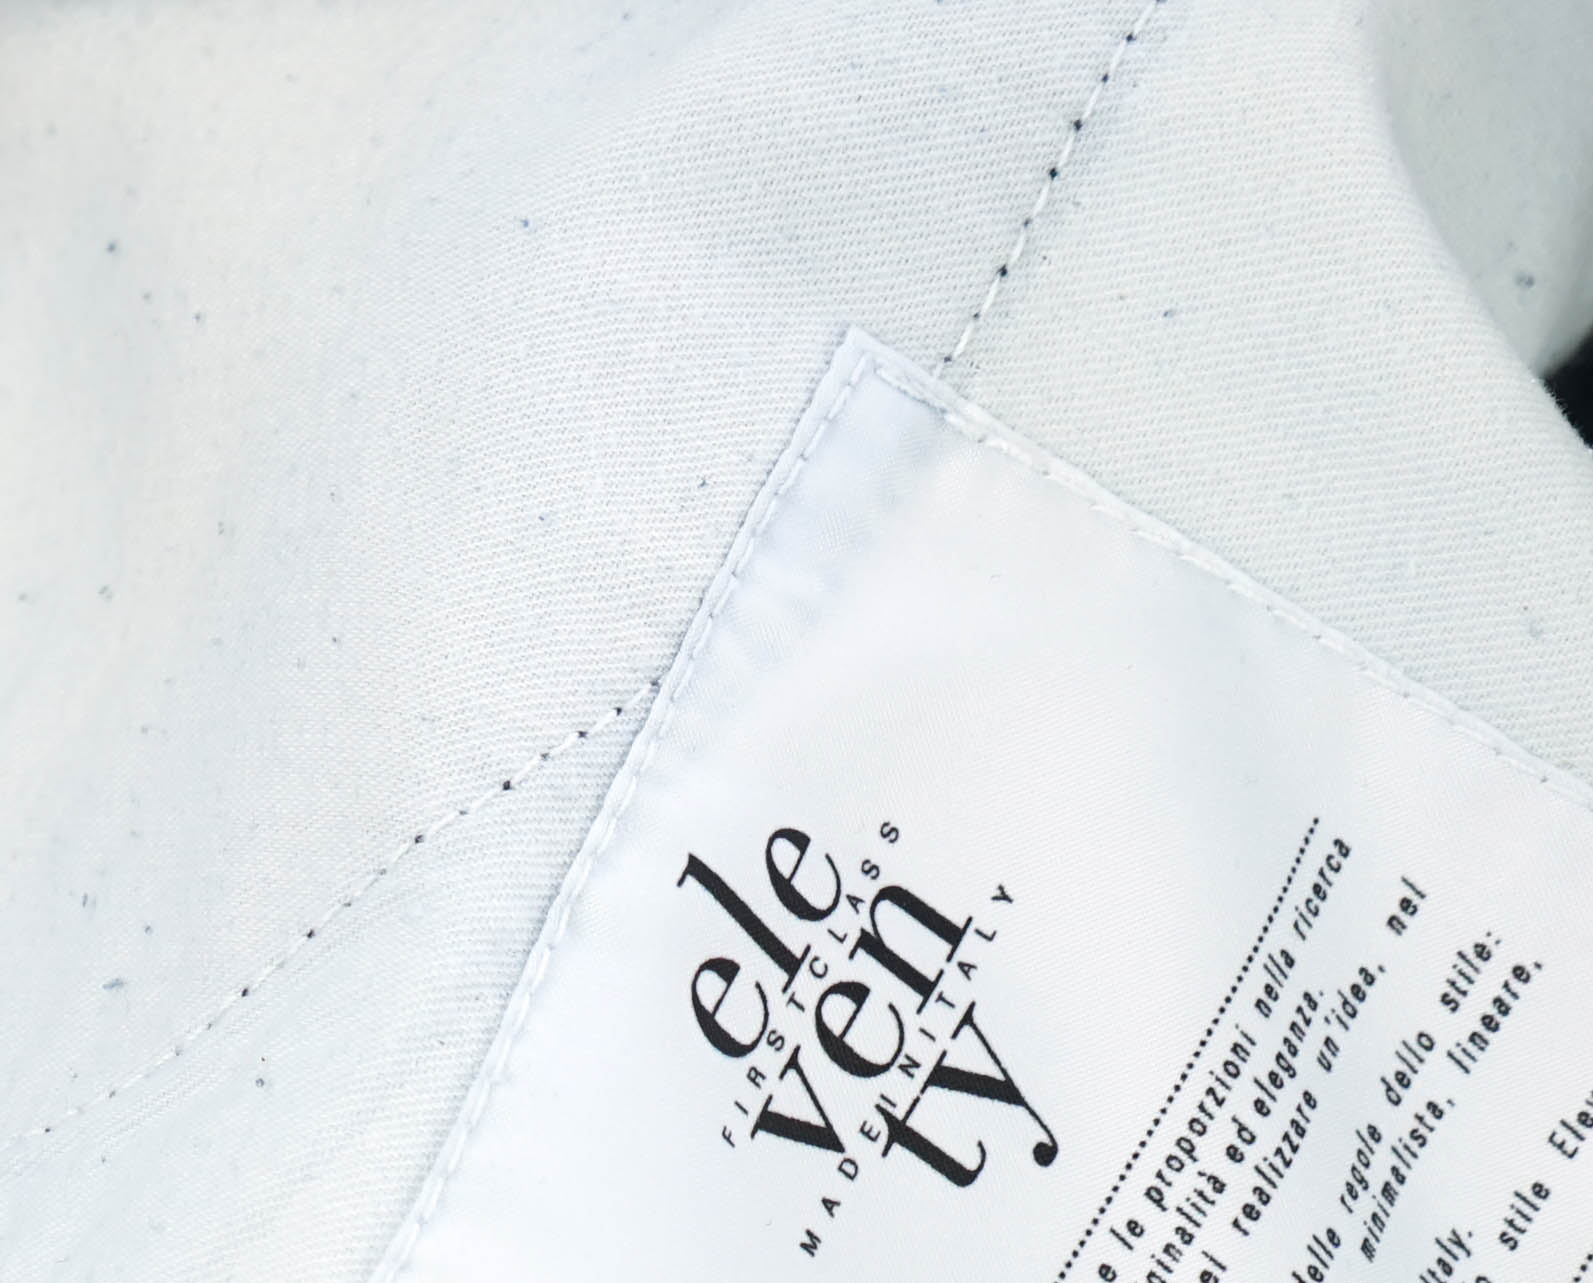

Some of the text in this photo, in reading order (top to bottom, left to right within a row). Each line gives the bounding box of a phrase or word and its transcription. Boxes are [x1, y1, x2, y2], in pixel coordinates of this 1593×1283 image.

[676, 827, 842, 1058] ele
[749, 884, 973, 1154] ven
[1096, 1261, 1118, 1283] e
[1108, 1217, 1146, 1252] le
[1142, 1022, 1257, 1213] proporzioni
[1252, 947, 1296, 1019] nella
[1291, 837, 1352, 942] ricerca
[1224, 1113, 1257, 1164] ed
[1251, 989, 1324, 1118] eleganza.
[1230, 1088, 1318, 1237] realizzare
[1315, 963, 1386, 1073] un'idea,
[1384, 875, 1427, 937] nel
[1338, 1122, 1383, 1215] regole
[1379, 1030, 1436, 1107] dello
[1438, 930, 1502, 1014] stile:
[873, 1000, 1059, 1188] ty
[1358, 1097, 1455, 1264] minimalista,
[1445, 960, 1543, 1075] lineare,
[1497, 1180, 1551, 1252] stile
